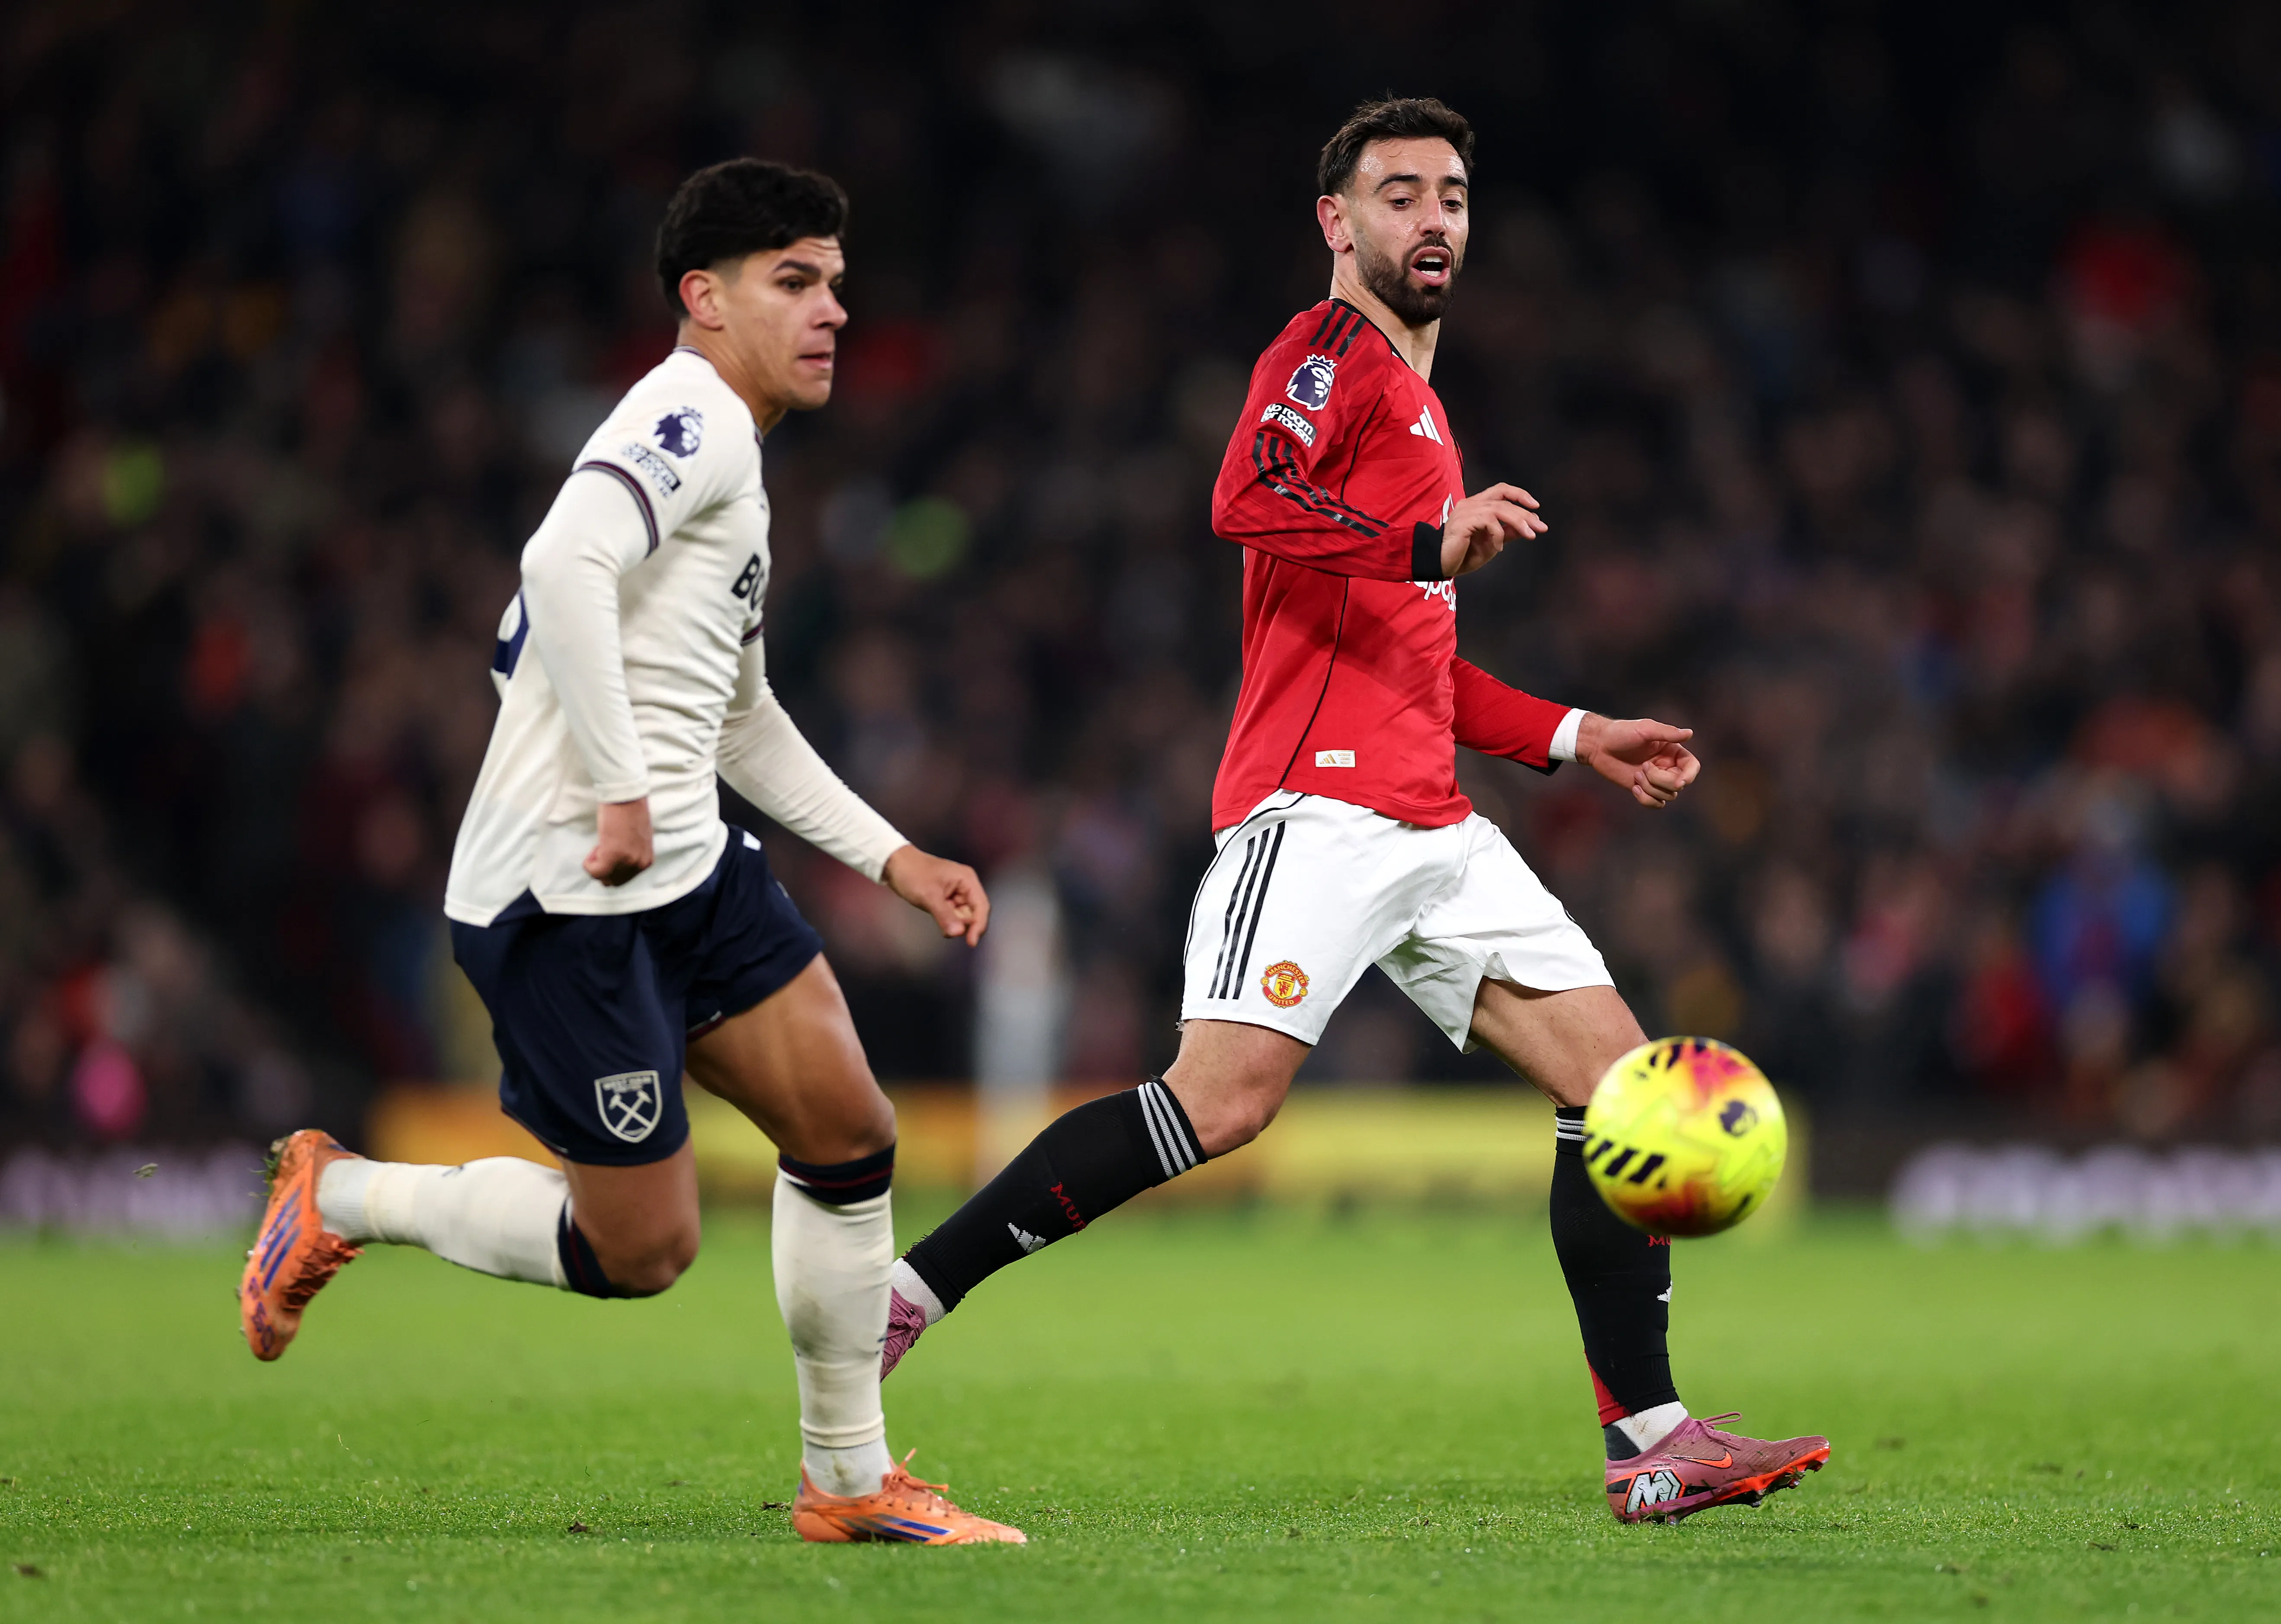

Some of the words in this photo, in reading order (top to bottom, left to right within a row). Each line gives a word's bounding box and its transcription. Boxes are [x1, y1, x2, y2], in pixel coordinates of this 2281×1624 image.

[1264, 404, 1282, 414] No
[1282, 407, 1313, 436] room
[1277, 414, 1313, 448] racism
[1267, 964, 1306, 984] MANCHESTER
[1267, 993, 1294, 1005] UNITED
